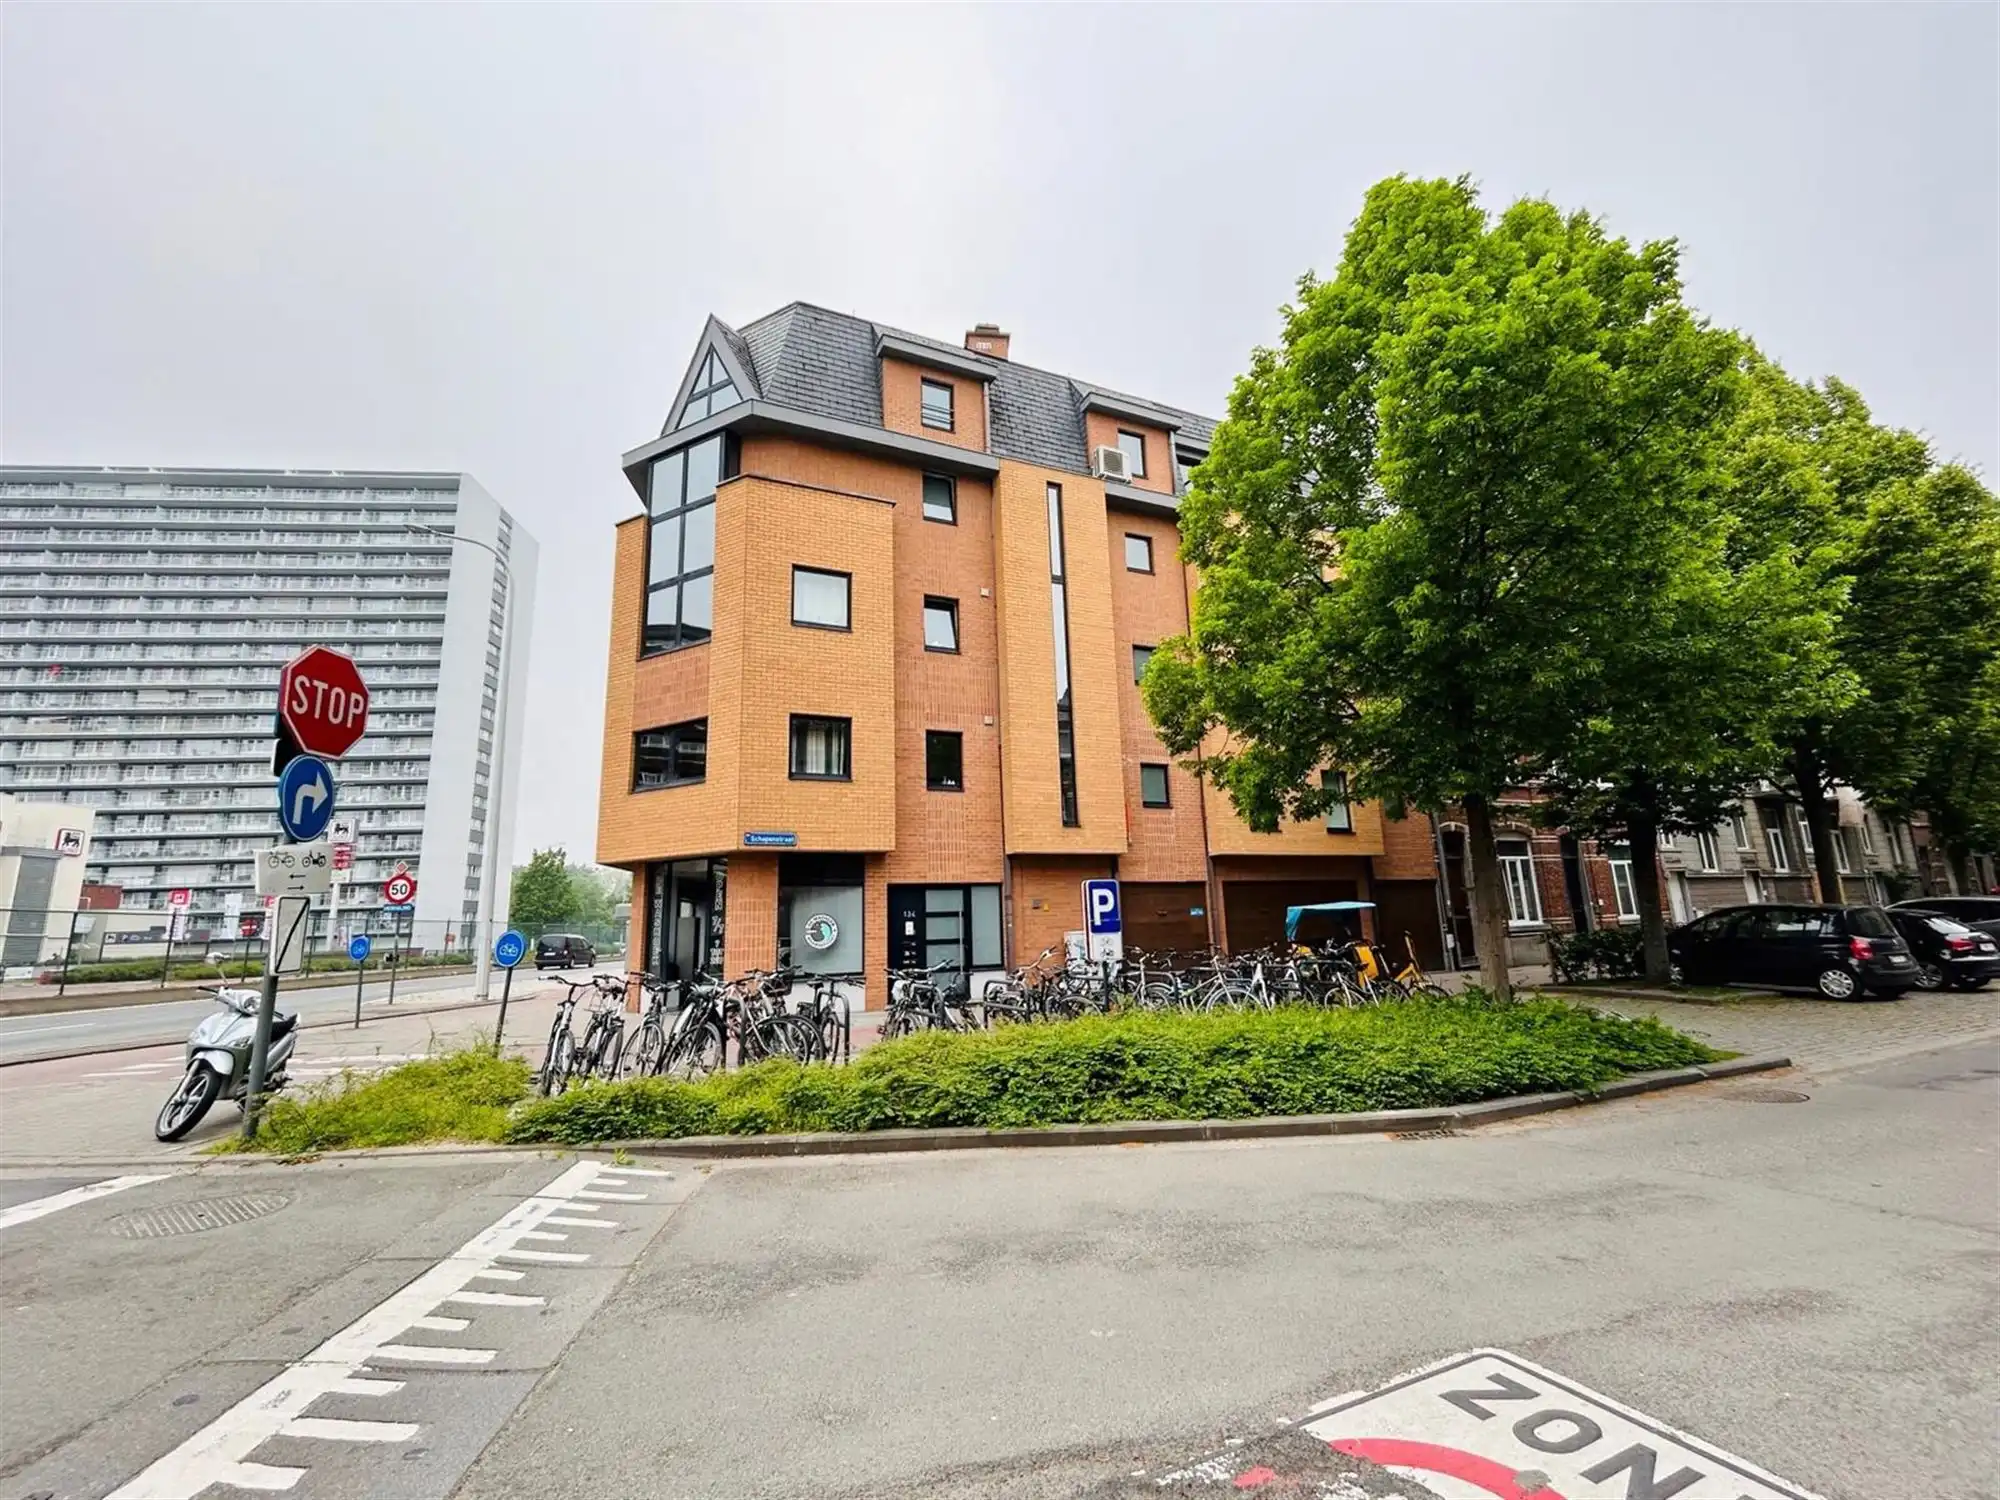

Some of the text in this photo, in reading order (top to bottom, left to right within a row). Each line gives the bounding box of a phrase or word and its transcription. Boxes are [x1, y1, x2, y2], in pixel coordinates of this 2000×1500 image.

[292, 675, 364, 728] STOP
[391, 884, 408, 896] 50
[1091, 888, 1115, 926] P
[1438, 1372, 1756, 1500] ZON
